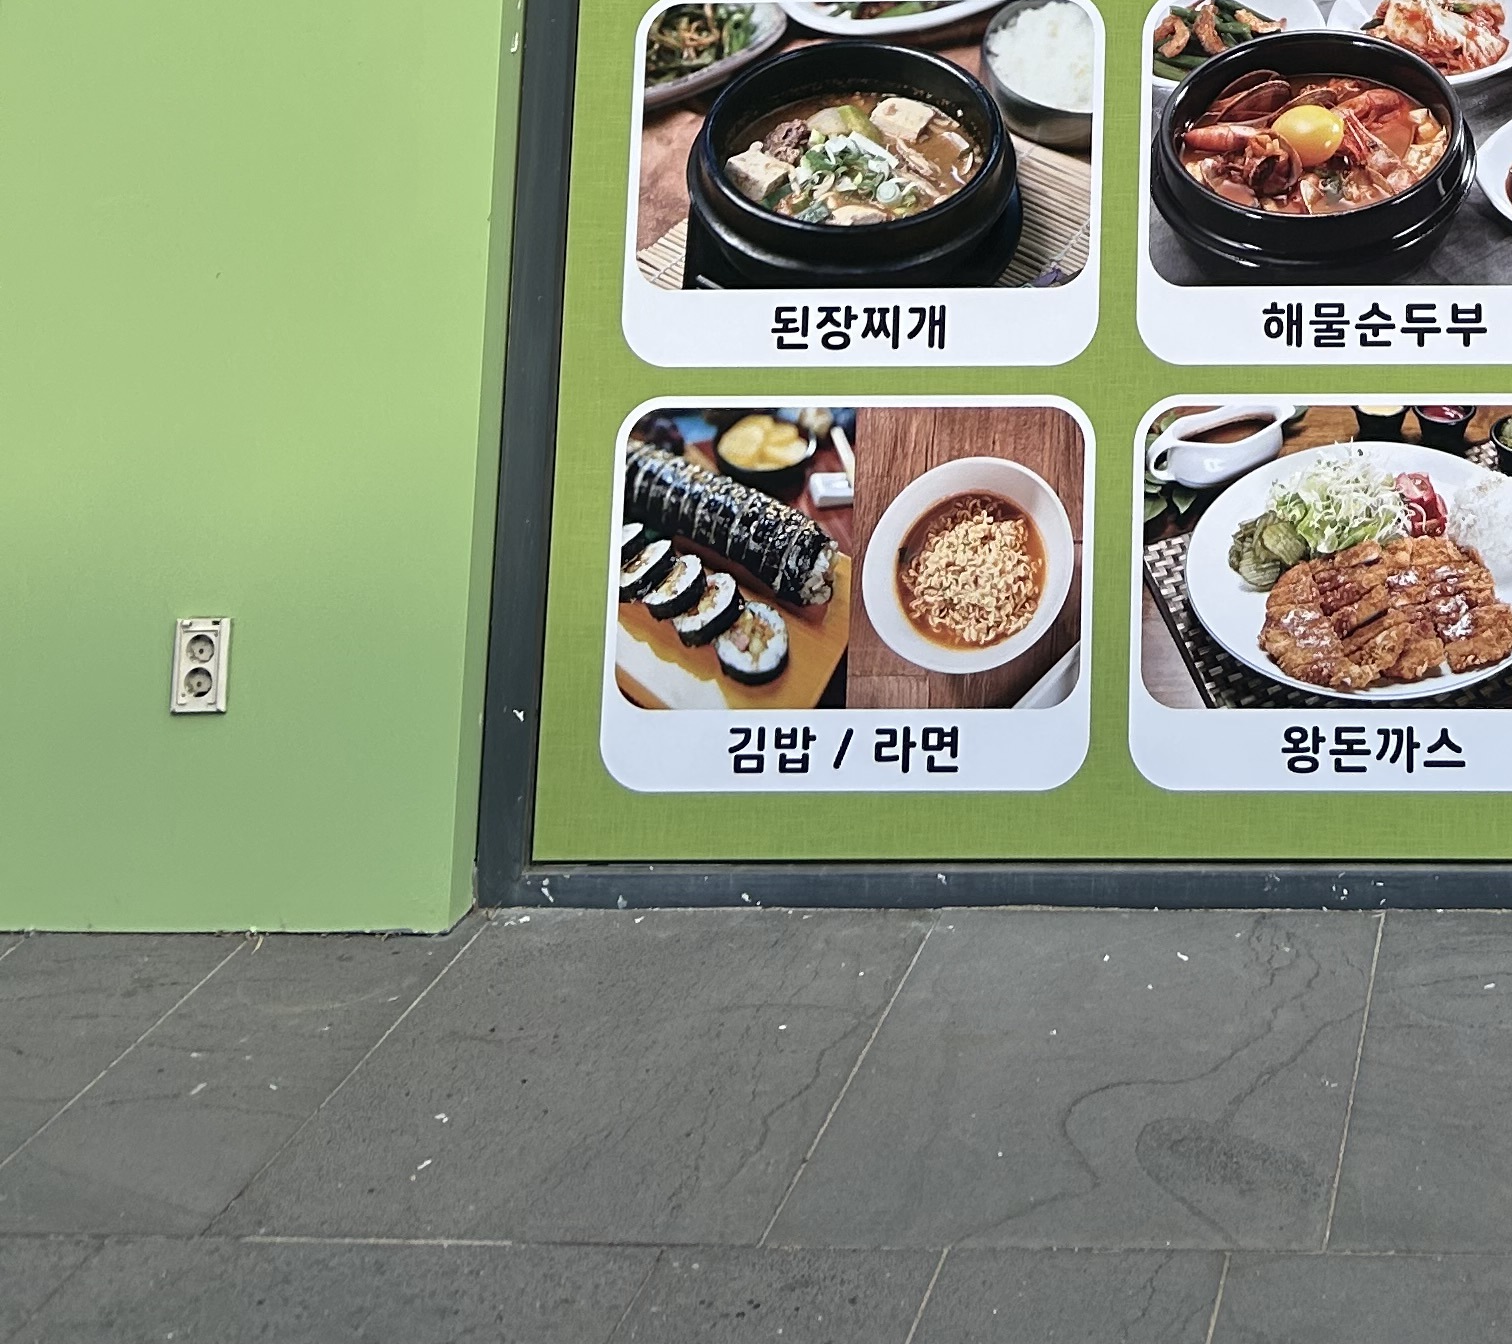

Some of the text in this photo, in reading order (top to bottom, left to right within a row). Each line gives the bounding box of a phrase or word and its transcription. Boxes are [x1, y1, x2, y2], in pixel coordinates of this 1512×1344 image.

[771, 304, 947, 351] 된장찌개
[1262, 301, 1488, 348] 해물순두부
[727, 726, 811, 775] 김밥
[872, 725, 961, 776] 라면
[1281, 725, 1466, 775] 왕돈까스
